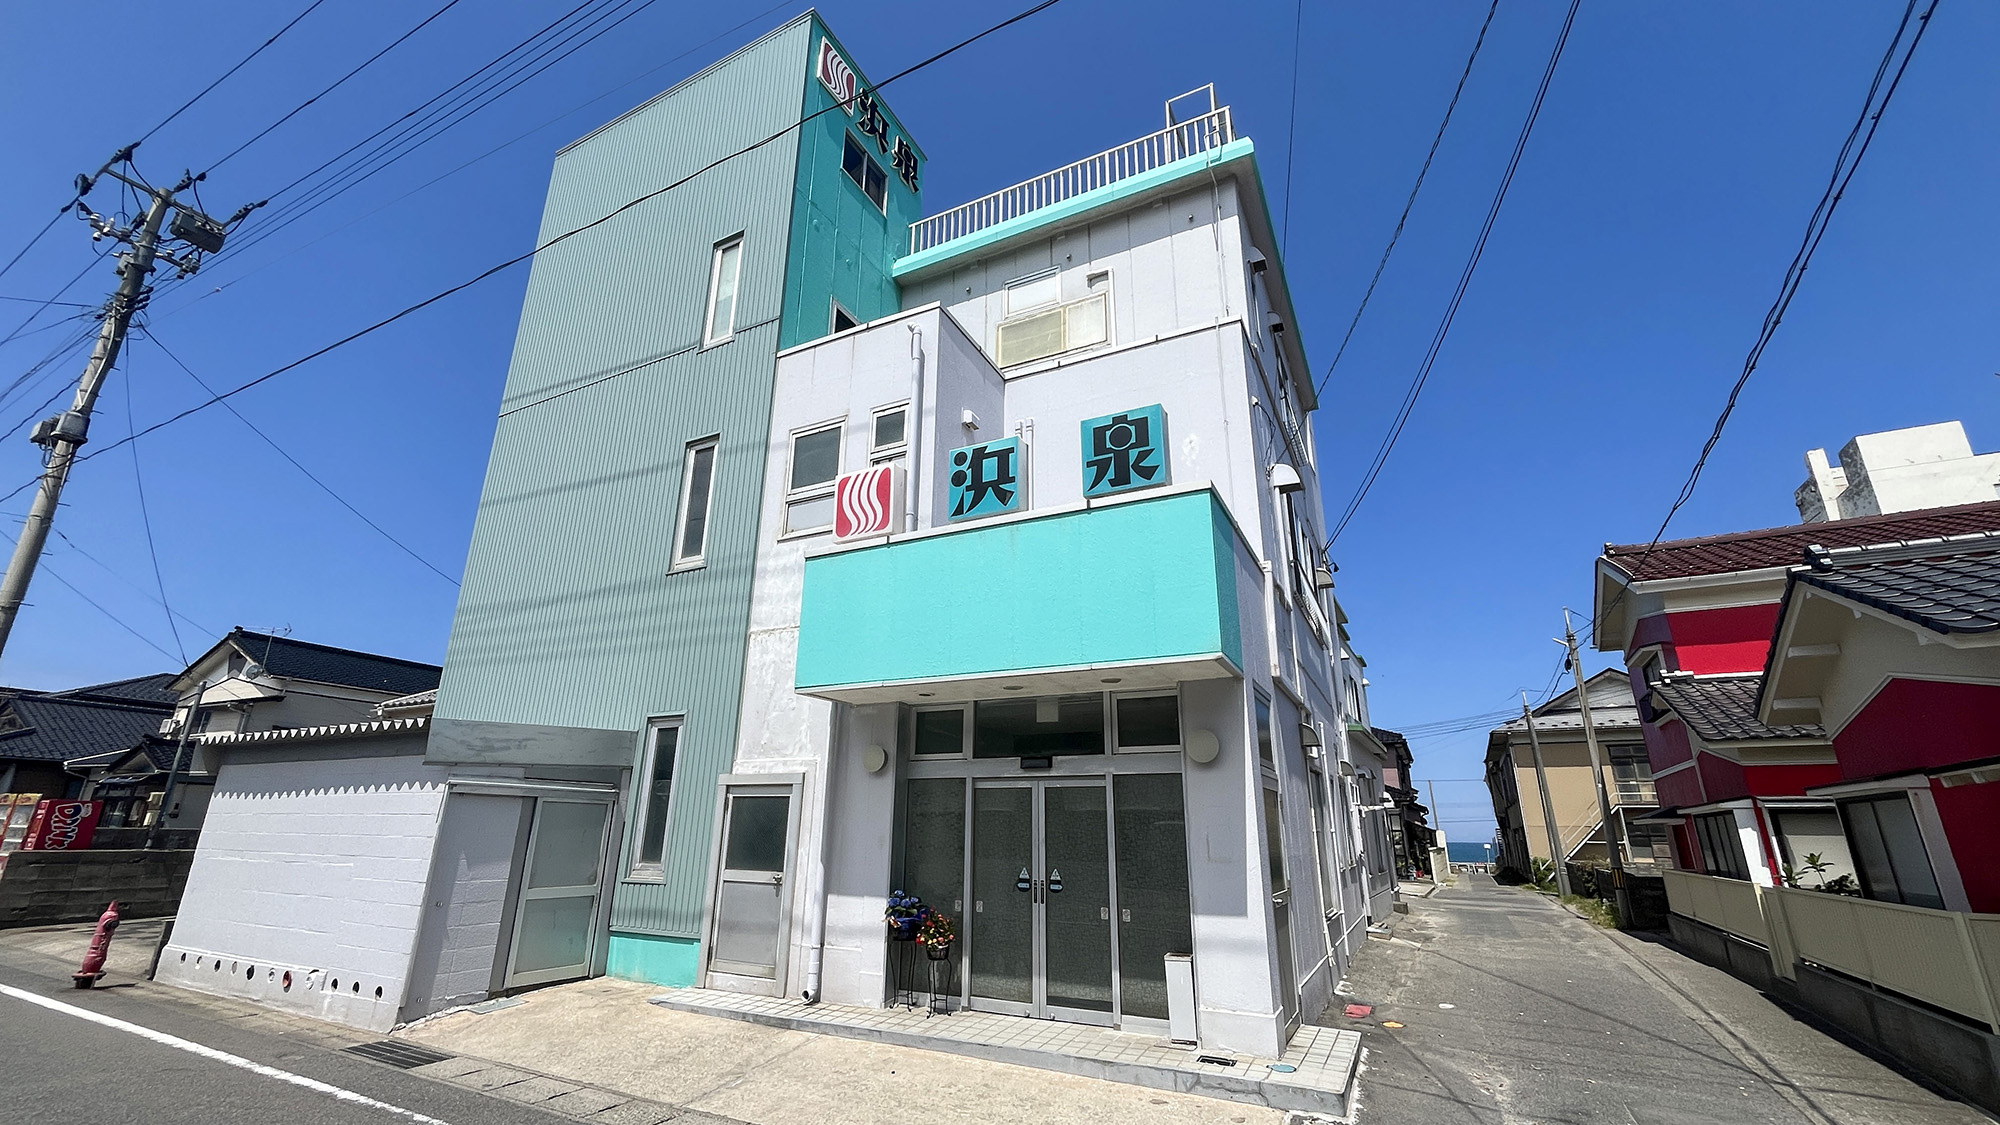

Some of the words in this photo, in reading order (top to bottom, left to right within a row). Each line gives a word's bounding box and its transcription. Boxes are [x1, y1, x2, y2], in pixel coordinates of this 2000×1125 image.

[856, 87, 919, 193] 浜泉
[950, 414, 1160, 517] 浜泉
[45, 802, 84, 850] DRINK
